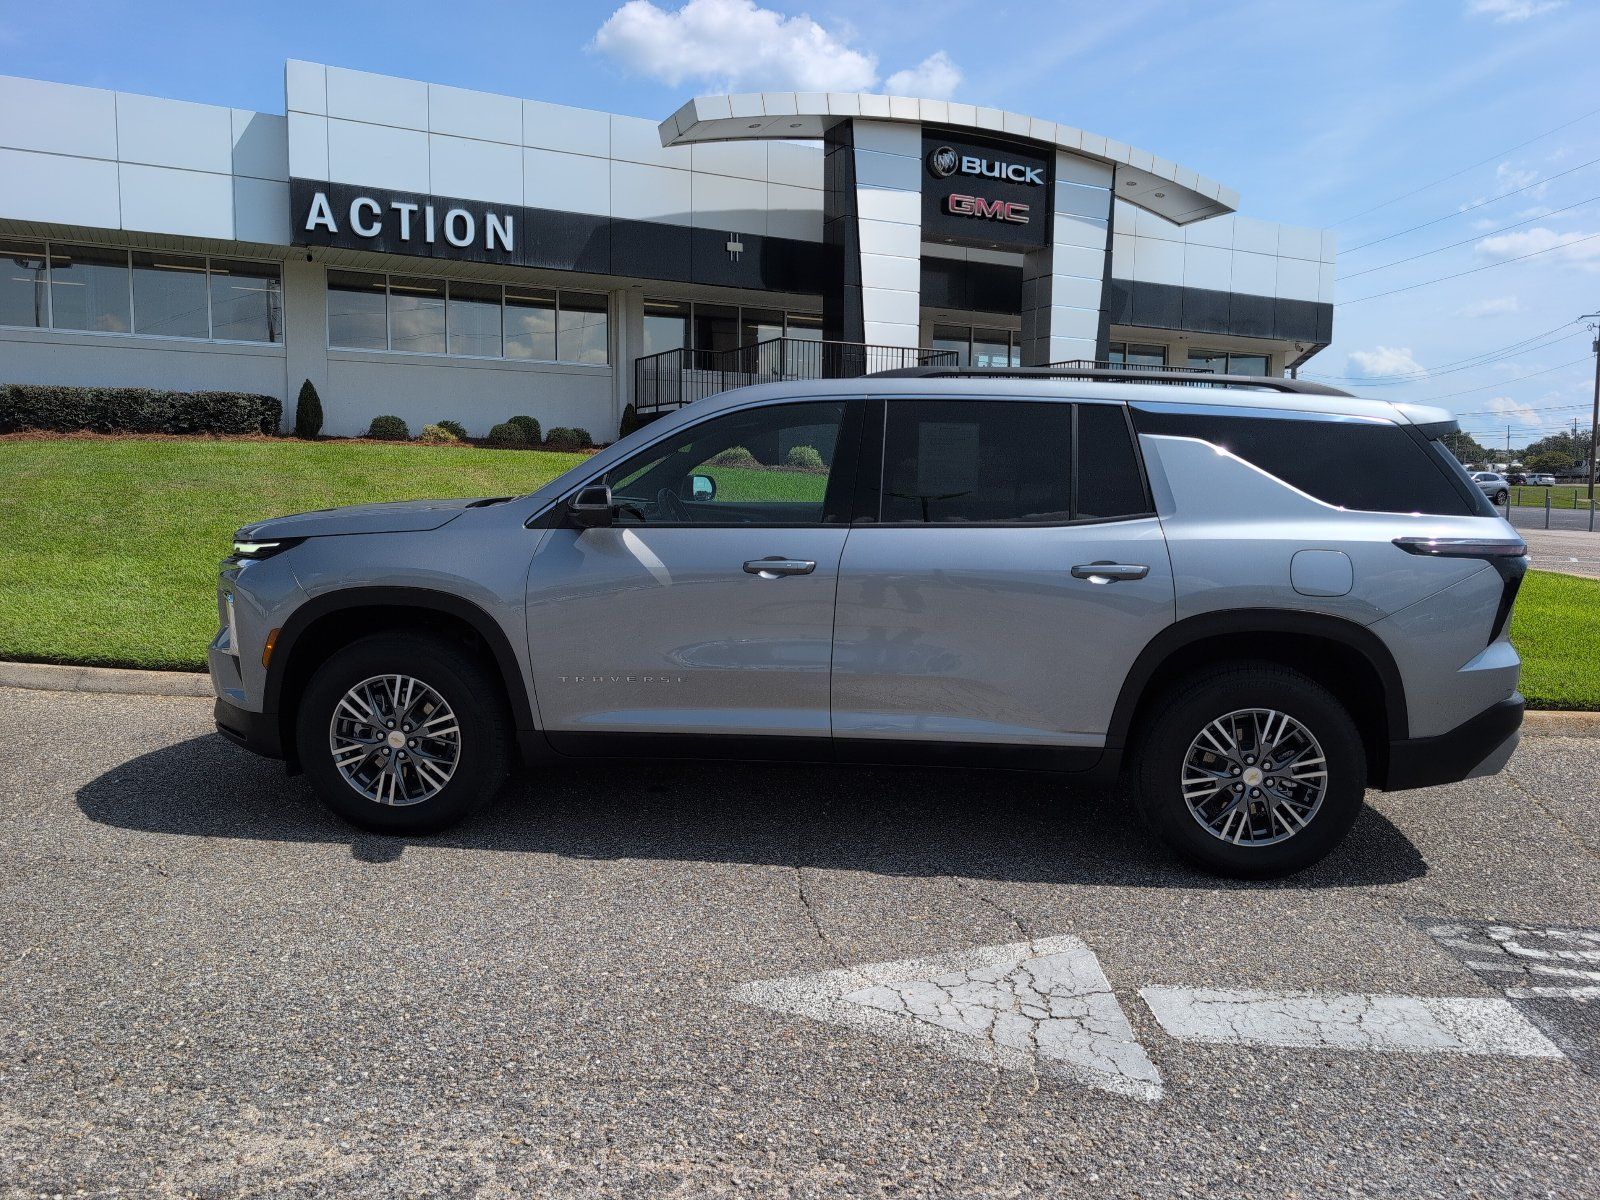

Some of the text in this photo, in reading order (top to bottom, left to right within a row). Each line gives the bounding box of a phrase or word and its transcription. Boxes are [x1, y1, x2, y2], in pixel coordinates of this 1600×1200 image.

[961, 155, 1045, 185] BUICK
[305, 192, 514, 252] ACTION
[948, 193, 1030, 224] GMC
